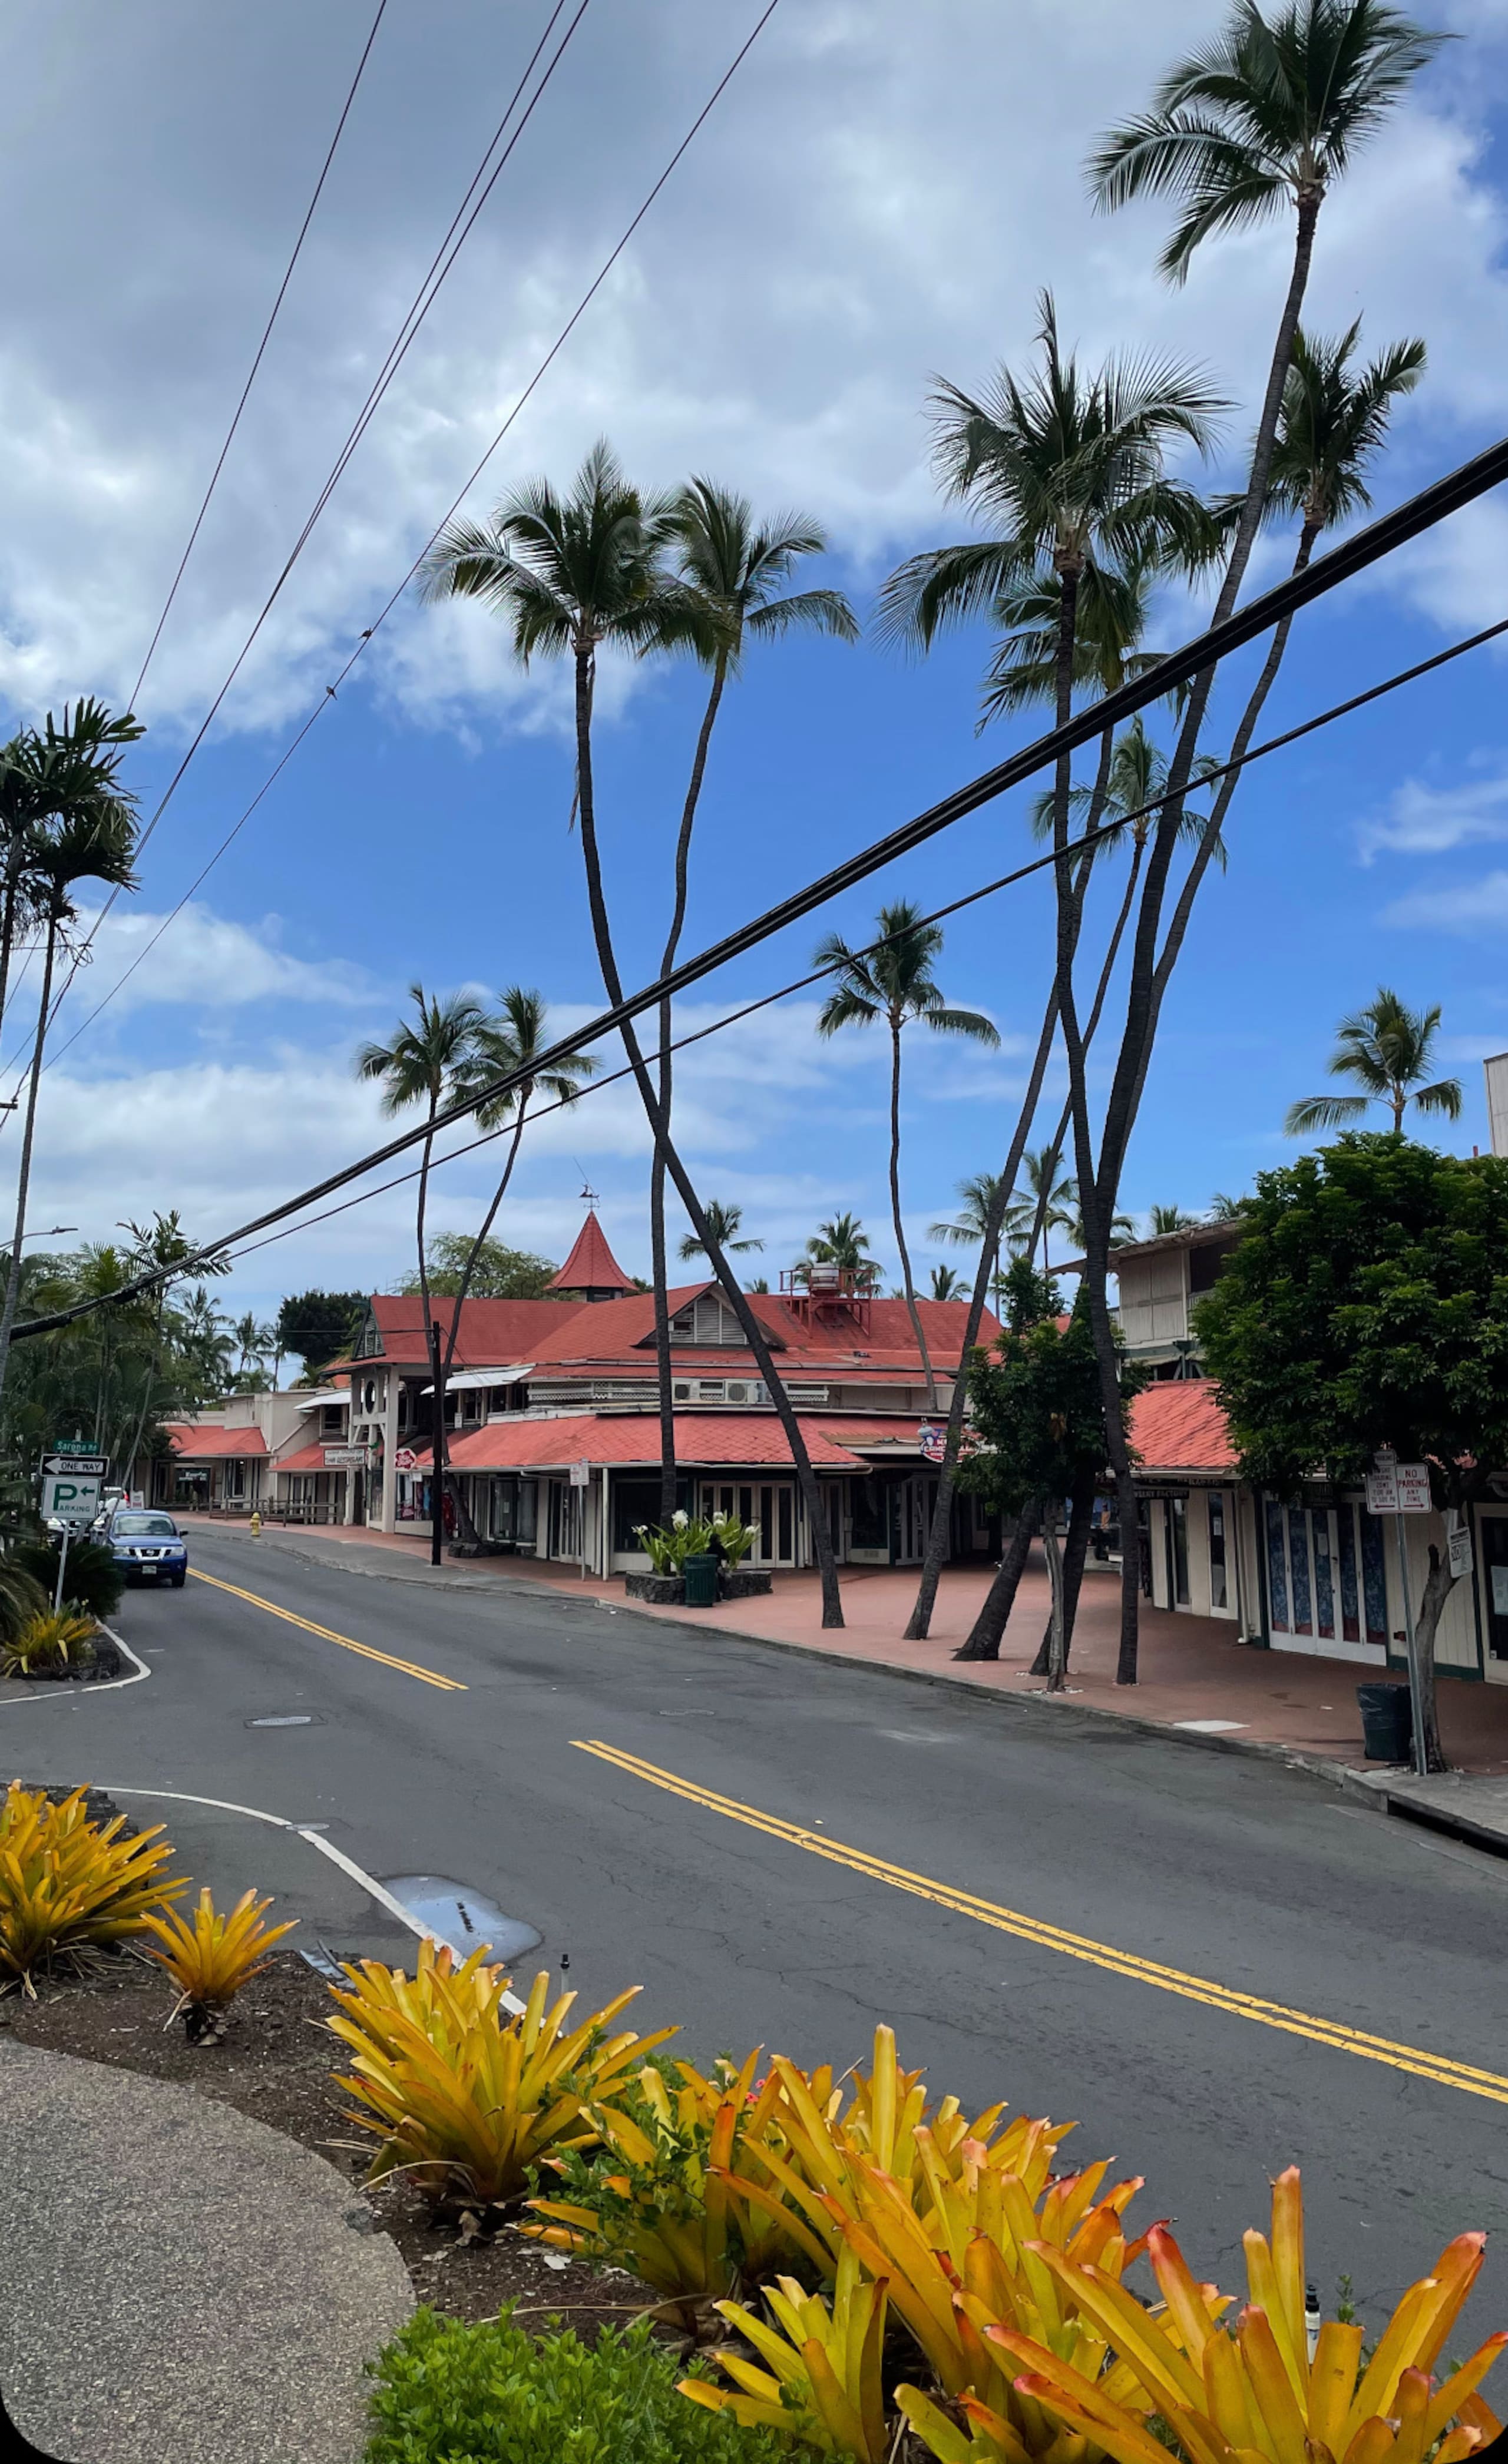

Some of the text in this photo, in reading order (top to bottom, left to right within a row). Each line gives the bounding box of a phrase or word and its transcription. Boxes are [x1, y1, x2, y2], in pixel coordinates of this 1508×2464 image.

[61, 1462, 101, 1471] ONE WAY
[1404, 1468, 1418, 1478] NO
[1398, 1479, 1428, 1488] PARKING
